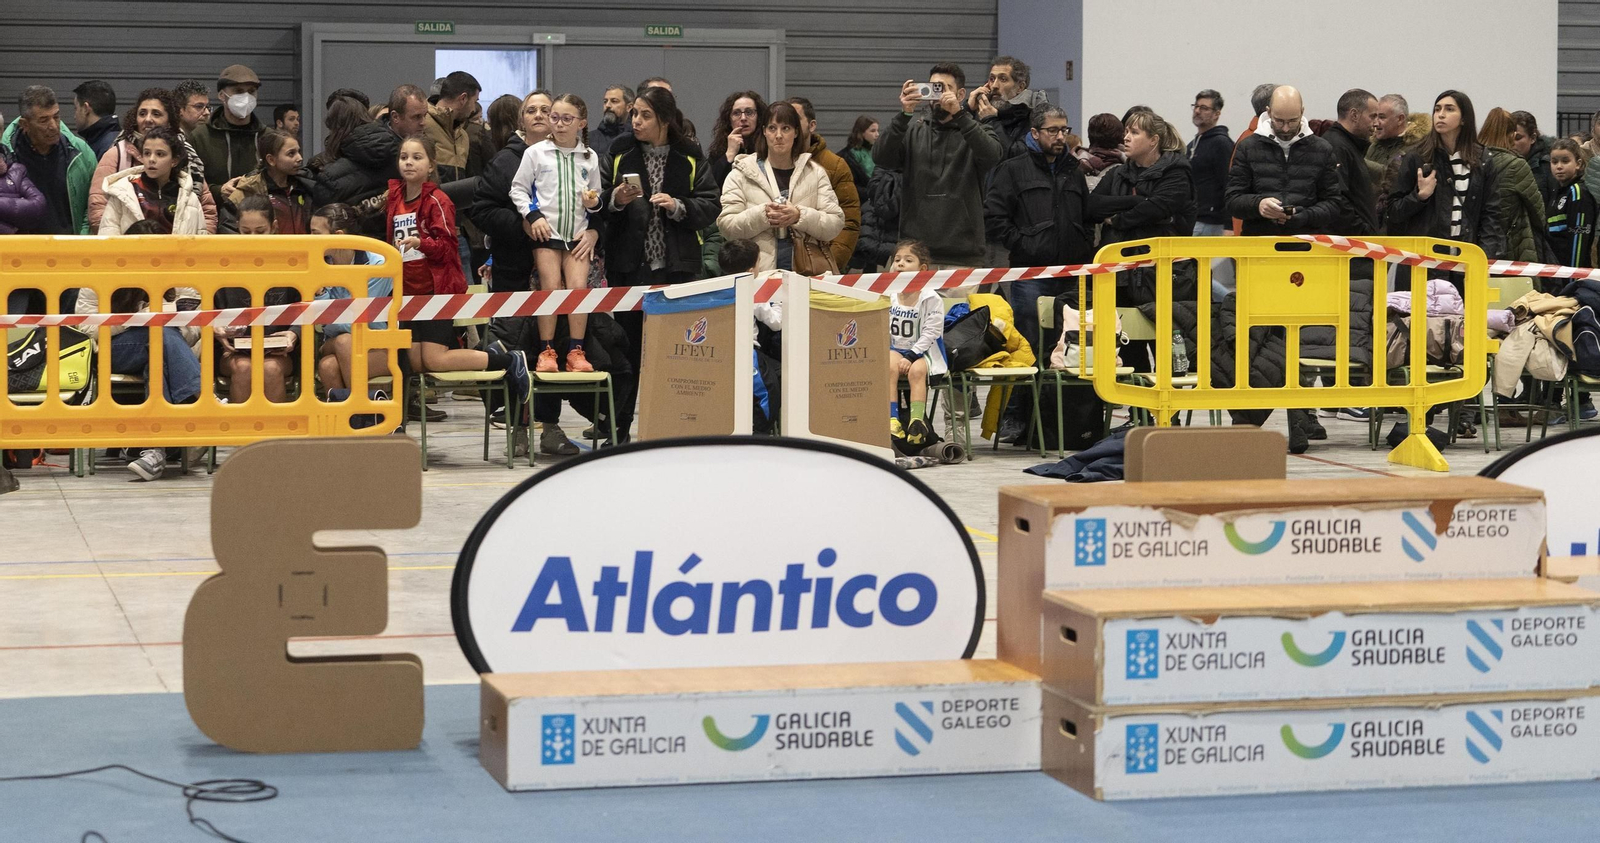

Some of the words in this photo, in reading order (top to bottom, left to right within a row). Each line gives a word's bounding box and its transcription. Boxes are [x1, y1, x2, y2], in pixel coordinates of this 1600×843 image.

[418, 23, 452, 32] SALIDA
[647, 26, 681, 36] SALIDA
[394, 215, 417, 229] ántic
[890, 317, 914, 338] 60
[674, 343, 715, 358] IFEVI
[828, 347, 867, 361] IFEVI
[1113, 521, 1173, 538] XUNTA
[1291, 518, 1361, 536] GALICIA
[1445, 524, 1510, 538] GALEGO
[1112, 541, 1134, 559] DE
[1137, 539, 1209, 558] GALICIA
[1291, 536, 1382, 555] SAUDABLE
[511, 547, 938, 637] Atlántico
[1511, 616, 1586, 631] DEPORTE
[1165, 631, 1227, 650] XUNTA
[1351, 628, 1424, 647] GALICIA
[1511, 632, 1578, 648] GALEGO
[1165, 653, 1187, 672] DE
[1191, 651, 1265, 671] GALICIA
[1351, 647, 1445, 667] SAUDABLE
[941, 697, 1020, 714] DEPORTE
[1511, 706, 1585, 722] DEPORTE
[582, 716, 646, 735] XUNTA
[775, 711, 851, 731] GALICIA
[941, 714, 1012, 730] GALEGO
[1351, 719, 1424, 739] GALICIA
[1511, 722, 1578, 738] GALEGO
[775, 729, 874, 751] SAUDABLE
[1165, 725, 1227, 744] XUNTA
[581, 739, 605, 757] DE
[609, 735, 686, 756] GALICIA
[1164, 747, 1187, 766] DE
[1191, 744, 1265, 765] GALICIA
[1351, 738, 1445, 759] SAUDABLE
